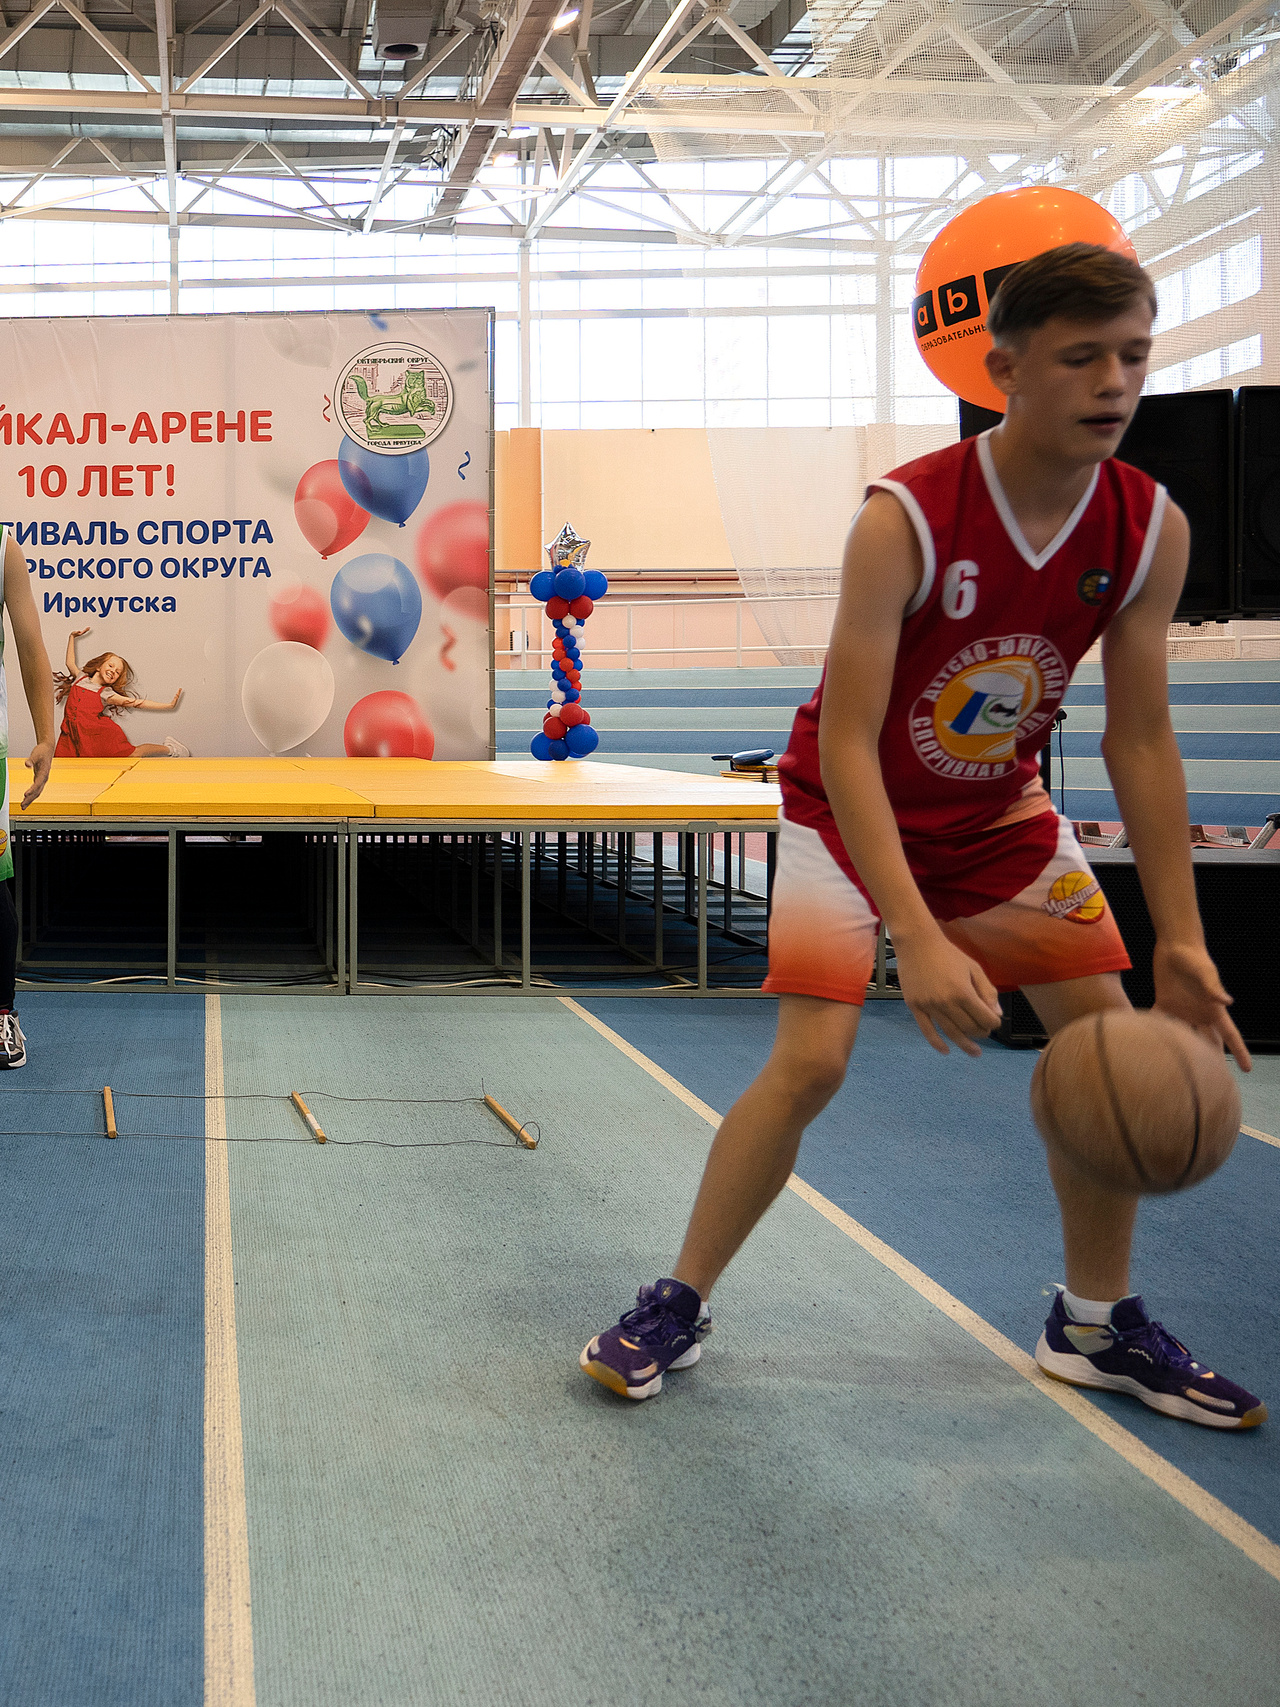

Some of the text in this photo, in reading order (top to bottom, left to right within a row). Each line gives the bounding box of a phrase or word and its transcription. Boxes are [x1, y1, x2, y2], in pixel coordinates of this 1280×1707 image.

[917, 288, 968, 327] ab
[921, 323, 987, 351] ОБРАЗОВАТЕЛЬН
[17, 464, 175, 498] 10 ЛЕТ!
[136, 519, 274, 545] СПОРТА
[26, 557, 272, 579] РЬСКОГО ОКРУГА
[43, 592, 177, 618] Иркутска
[942, 559, 980, 620] 6
[920, 638, 1063, 702] ДЕТСКО-ЮНЕСКАЯ
[912, 716, 1006, 778] СПОРТИВНАЯ
